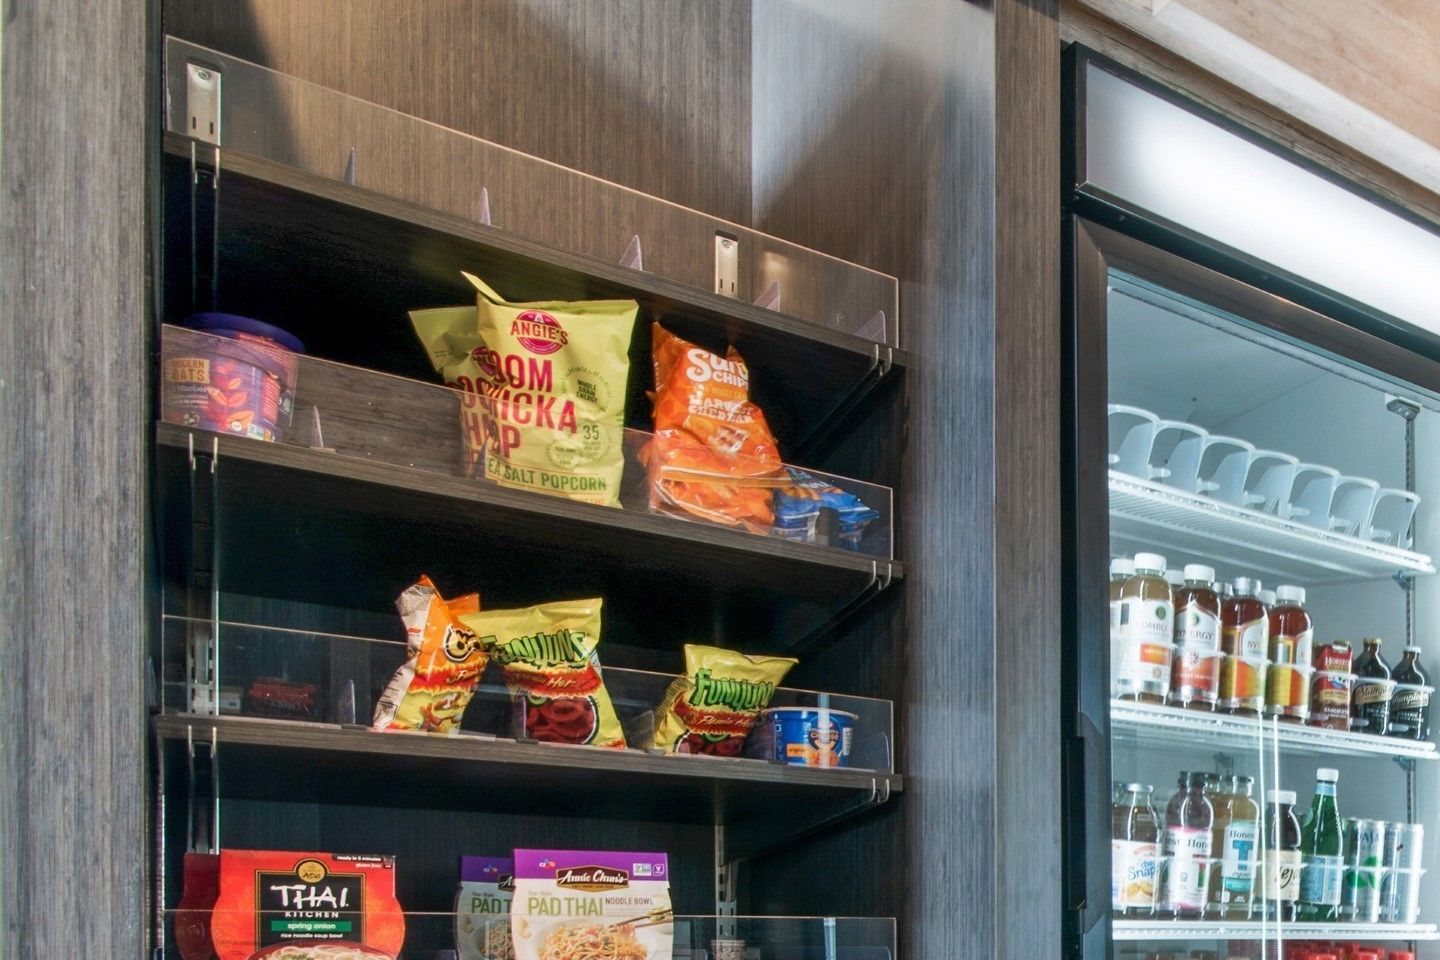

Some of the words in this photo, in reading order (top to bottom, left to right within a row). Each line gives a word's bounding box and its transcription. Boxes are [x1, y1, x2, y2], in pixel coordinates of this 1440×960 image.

[510, 319, 570, 347] ANGIE'S
[582, 424, 600, 441] 35
[503, 467, 535, 486] SALT
[540, 472, 608, 491] POPCORN
[558, 869, 590, 884] Annie
[591, 869, 627, 884] Chun's
[270, 884, 349, 910] THAI
[470, 897, 502, 914] PAD
[605, 897, 634, 905] NOODLE
[633, 897, 654, 905] BOWL
[285, 911, 340, 919] KITCHEN
[527, 896, 562, 916] PAD
[566, 897, 604, 917] THAI
[287, 922, 313, 931] spring
[313, 922, 337, 930] onion
